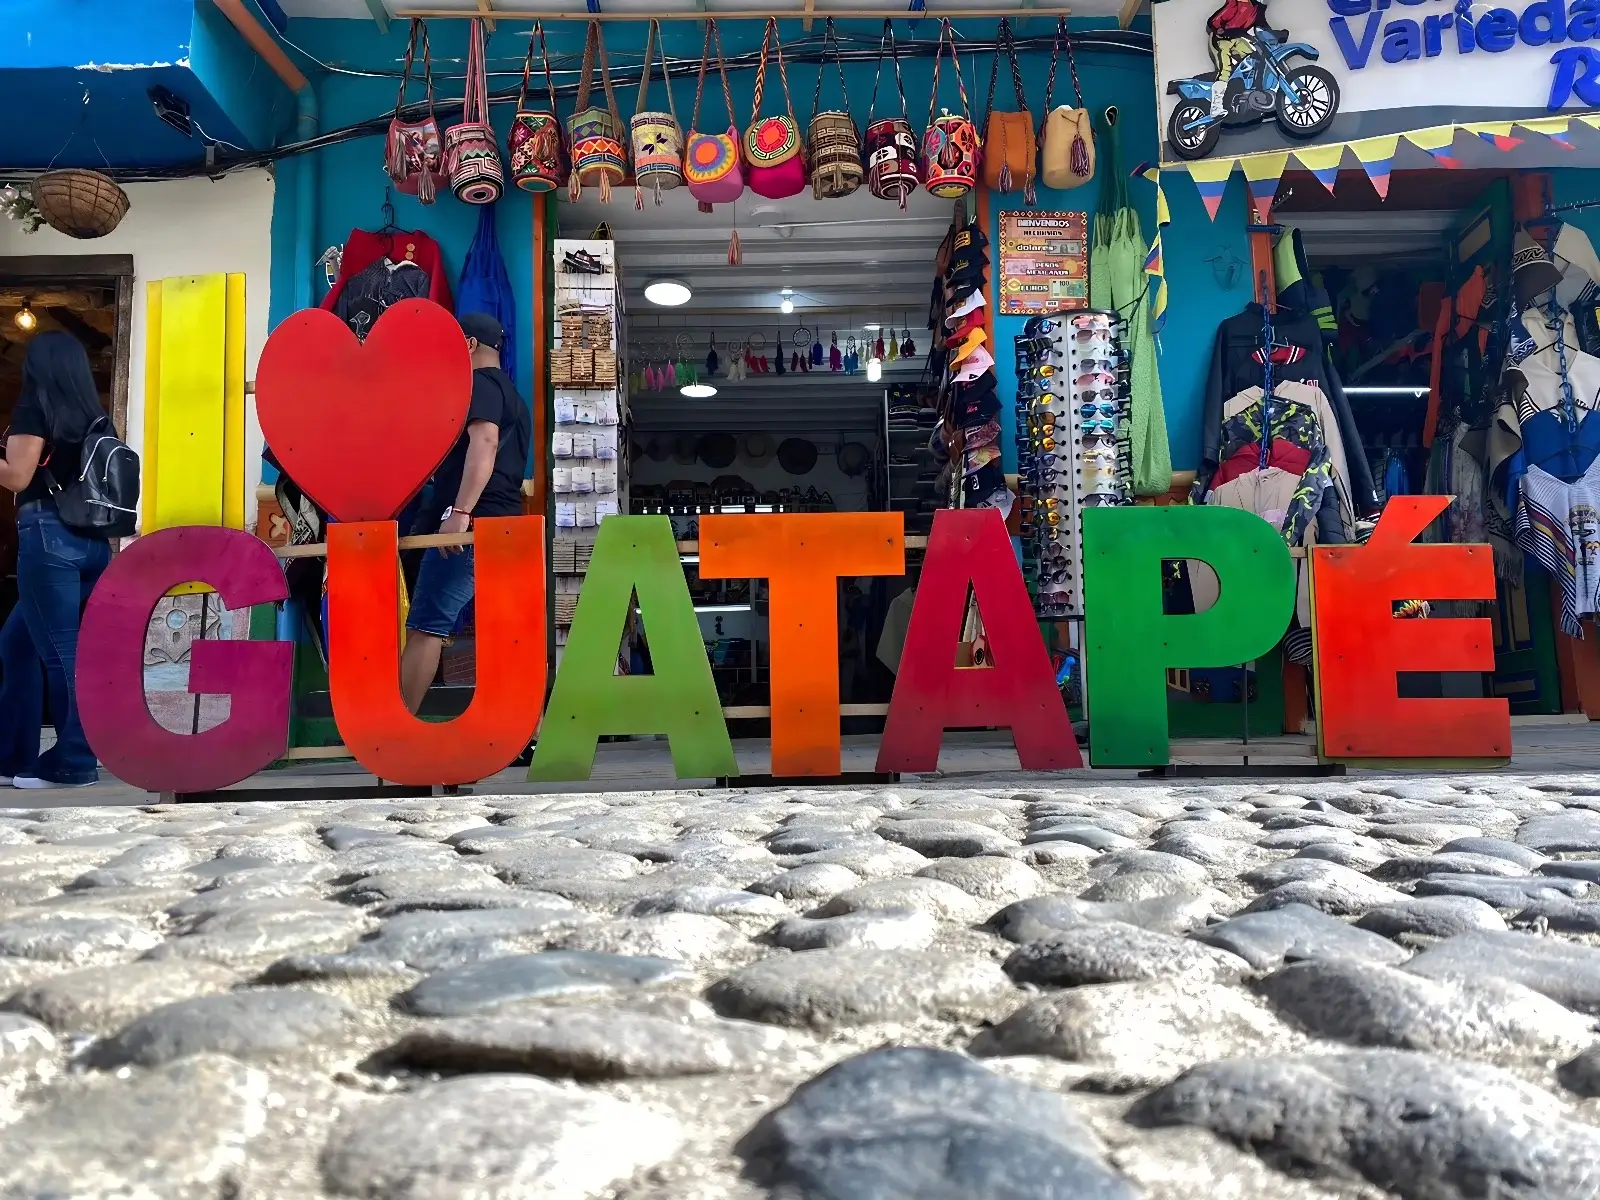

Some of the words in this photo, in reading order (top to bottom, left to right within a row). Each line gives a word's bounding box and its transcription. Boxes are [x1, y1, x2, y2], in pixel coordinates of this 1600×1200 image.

[1017, 219, 1070, 228] BIENVENIDOS
[1020, 284, 1049, 292] EUROS
[75, 495, 1512, 792] GUATAPÉ
